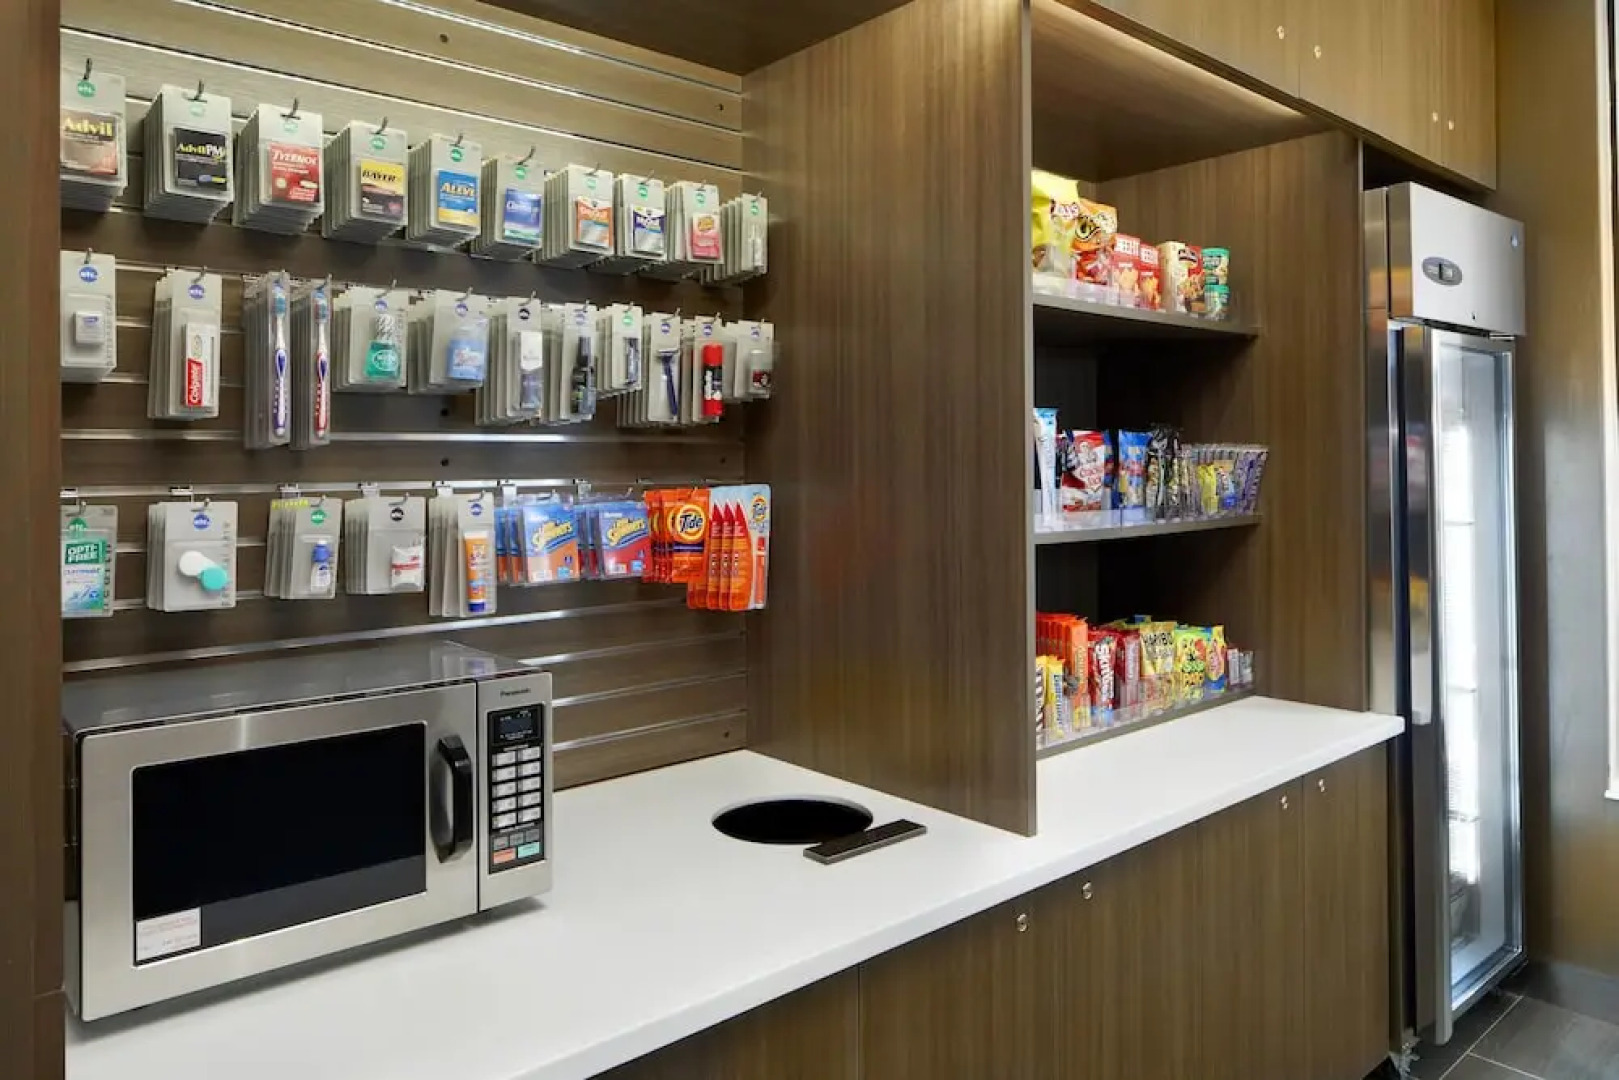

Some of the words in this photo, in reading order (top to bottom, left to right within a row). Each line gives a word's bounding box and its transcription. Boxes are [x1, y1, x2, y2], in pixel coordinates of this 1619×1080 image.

[63, 116, 113, 137] Advil
[679, 514, 704, 532] Tide
[68, 544, 98, 555] OPTI-
[68, 553, 98, 562] FREE
[1142, 632, 1173, 646] HARIBO
